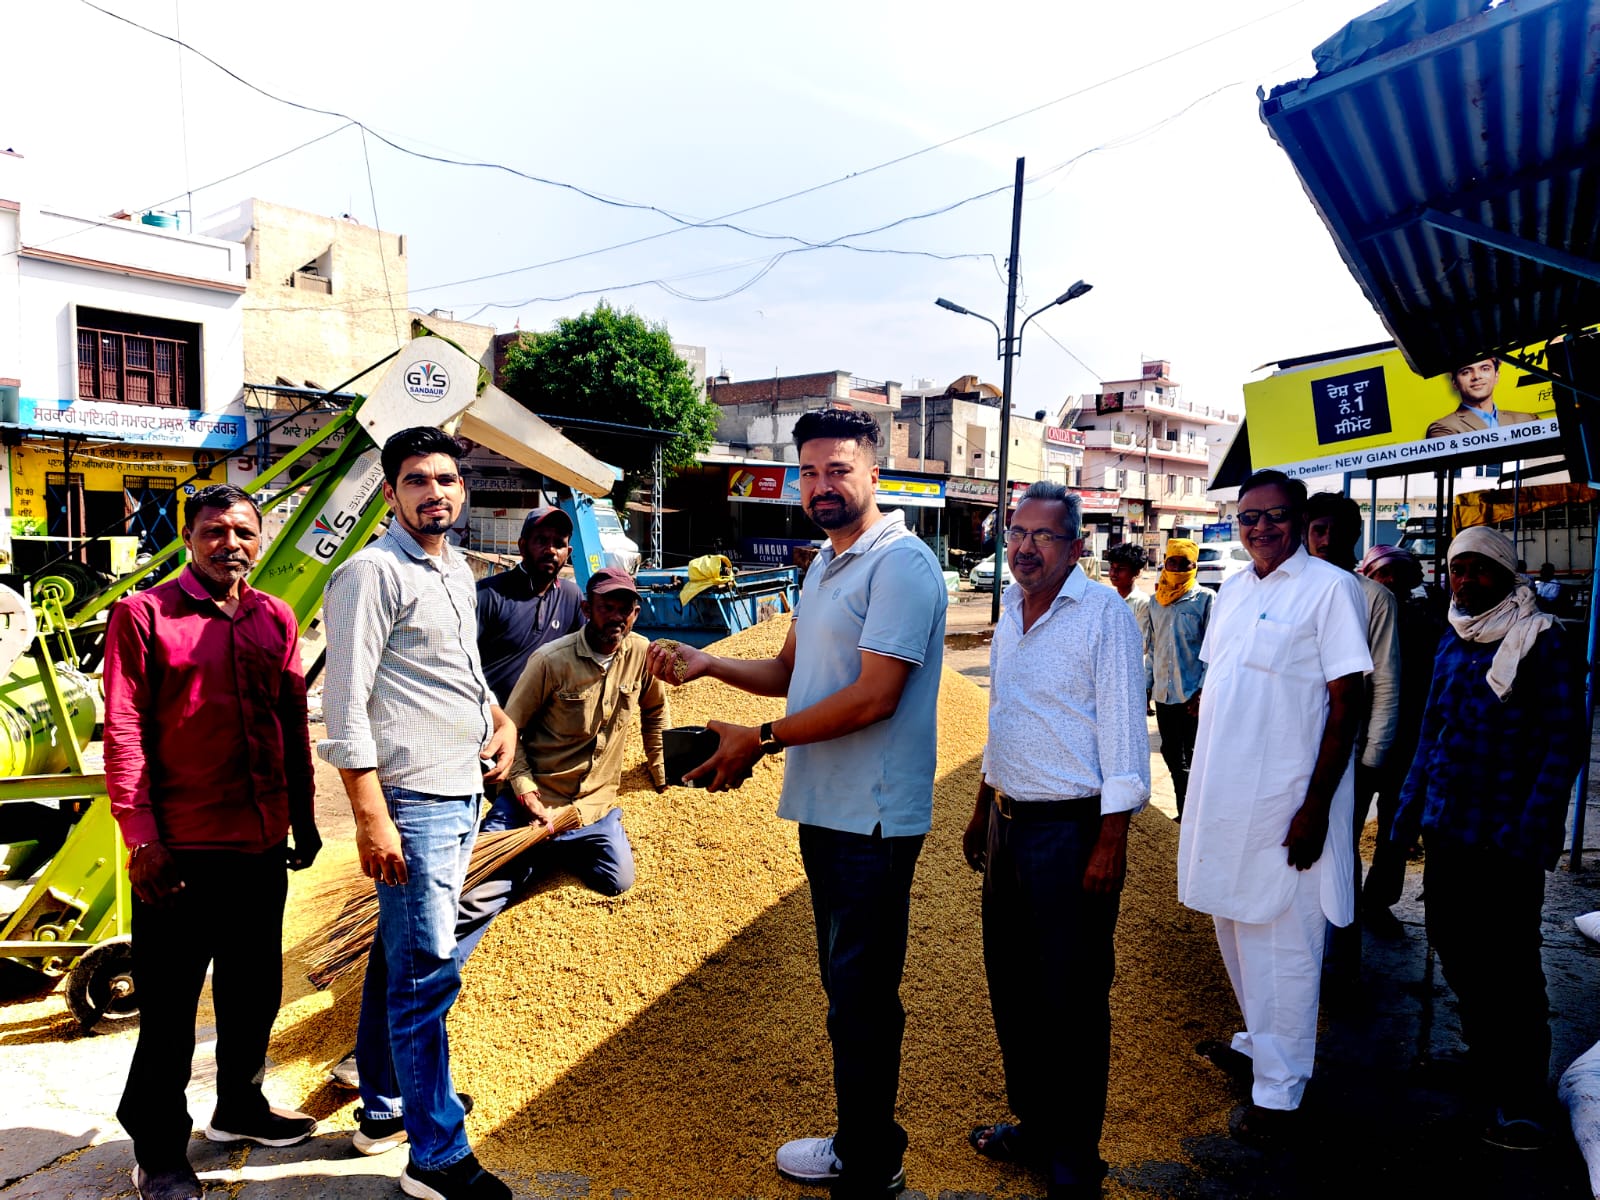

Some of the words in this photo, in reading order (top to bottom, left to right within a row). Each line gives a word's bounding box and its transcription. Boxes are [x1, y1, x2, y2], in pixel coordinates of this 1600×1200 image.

[409, 386, 444, 395] SANDAUR
[1326, 384, 1349, 399] ਦੇਸ਼
[1353, 380, 1370, 393] ਦਾ
[33, 406, 77, 423] ਸਰਕਾਰੀ
[1048, 427, 1071, 443] ONIDA
[1299, 463, 1332, 475] Dealer:
[1335, 455, 1363, 469] NEW
[1366, 449, 1398, 463] GIAN
[1400, 440, 1445, 457] CHAND
[1450, 439, 1458, 449] &
[1462, 432, 1499, 447] SONS
[1510, 424, 1546, 440] MOB:
